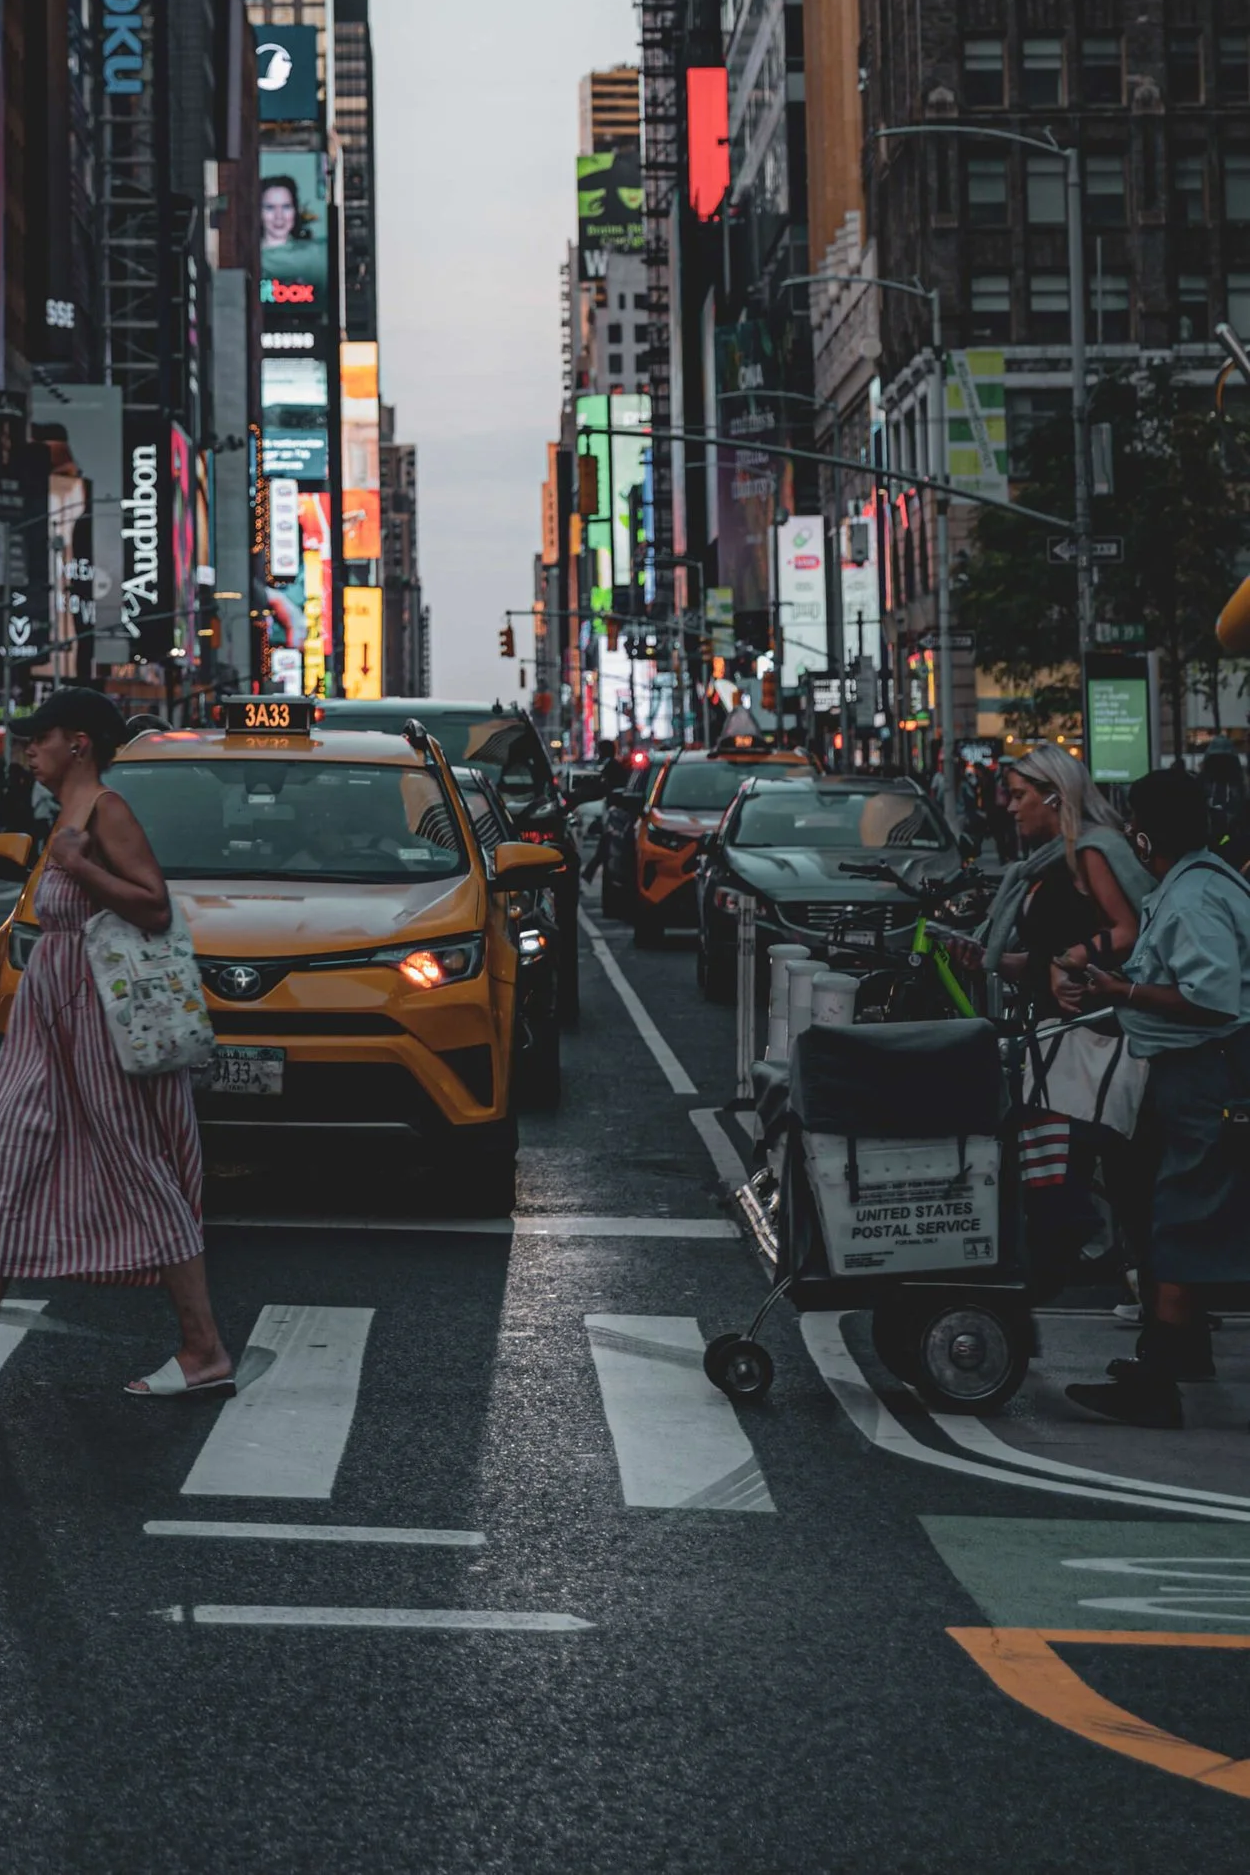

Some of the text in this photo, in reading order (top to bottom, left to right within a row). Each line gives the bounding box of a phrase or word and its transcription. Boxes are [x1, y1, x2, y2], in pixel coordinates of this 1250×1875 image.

[121, 444, 158, 605] Audubon
[245, 703, 290, 728] 3A33
[856, 1201, 973, 1222] UNITED STATES
[851, 1217, 981, 1240] POSTAL SERVICE
